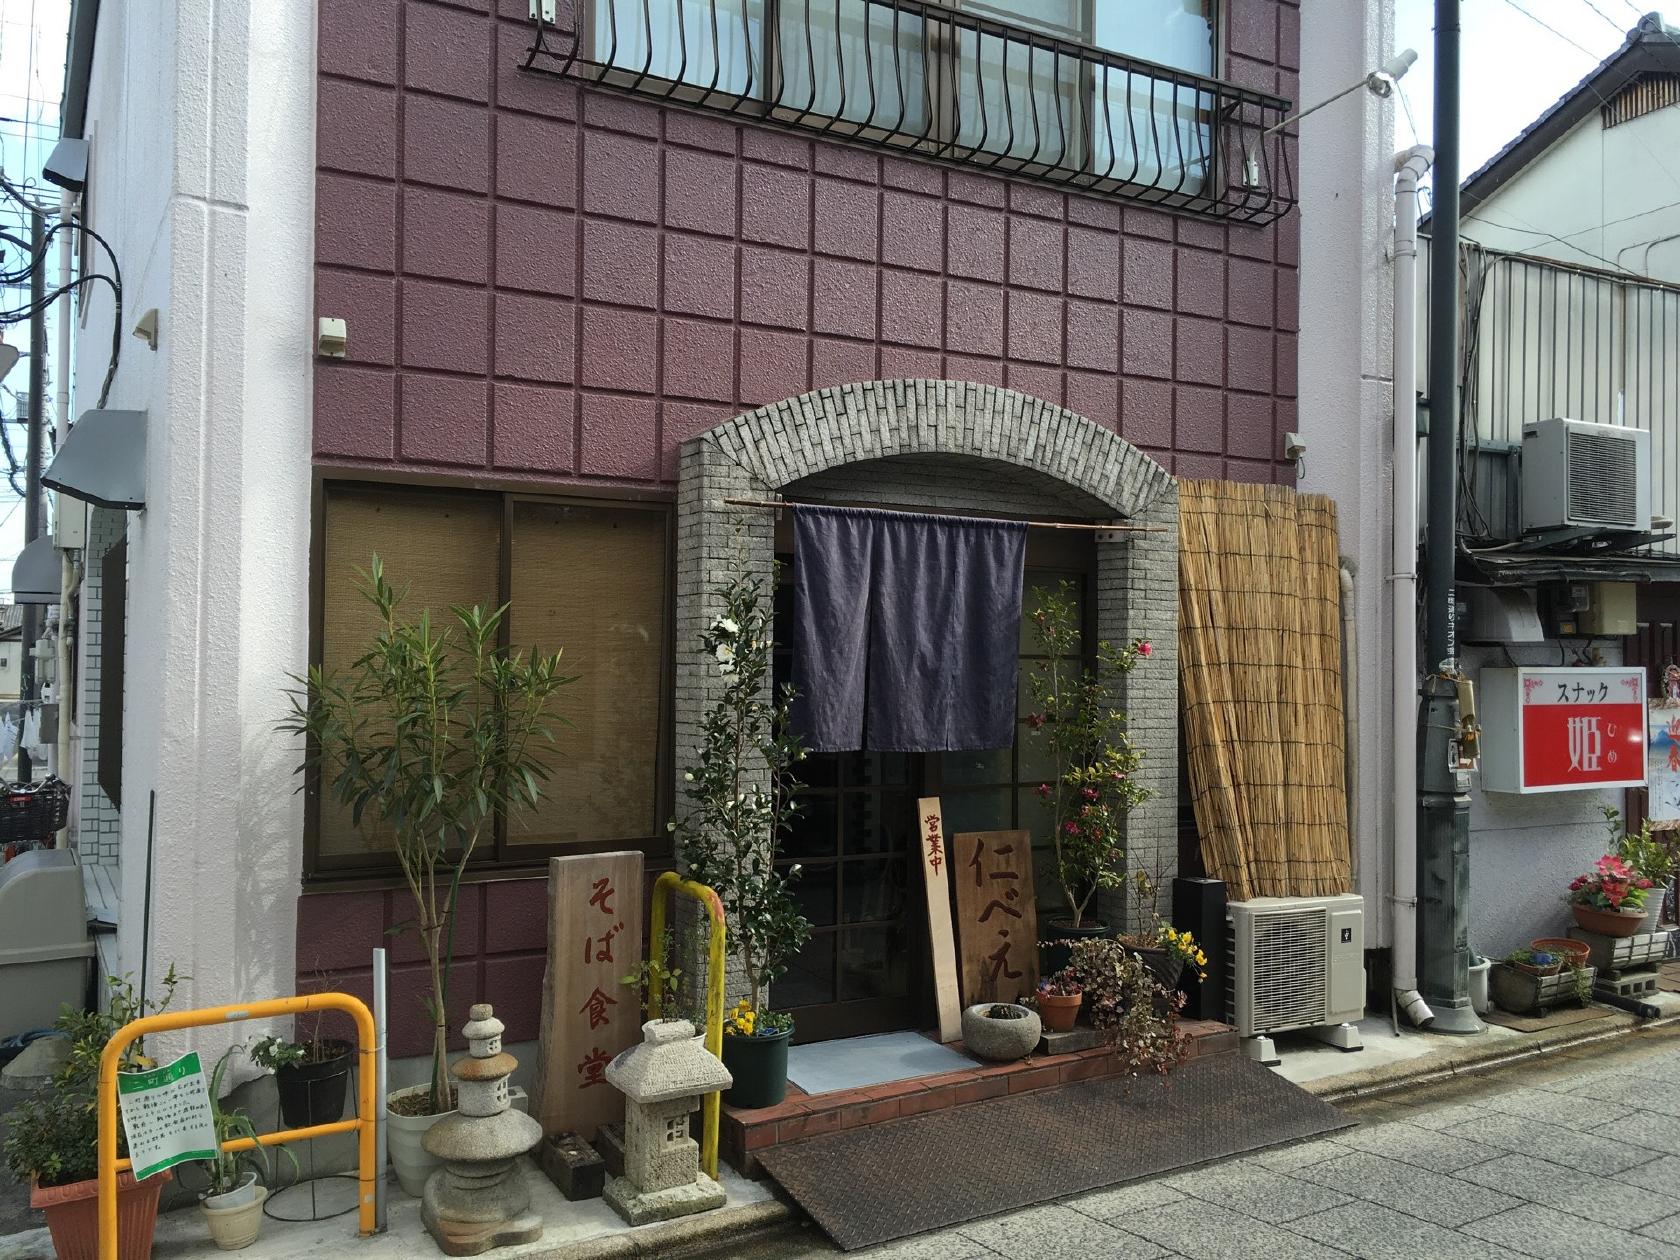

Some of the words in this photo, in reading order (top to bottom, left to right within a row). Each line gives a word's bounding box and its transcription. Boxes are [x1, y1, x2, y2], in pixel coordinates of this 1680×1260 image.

[1557, 681, 1609, 703] スナック
[1567, 716, 1602, 772] 姫
[1607, 722, 1617, 763] ひめ
[924, 814, 943, 876] 営業中
[968, 838, 1023, 981] 仁べえ
[577, 877, 625, 1090] そば食堂
